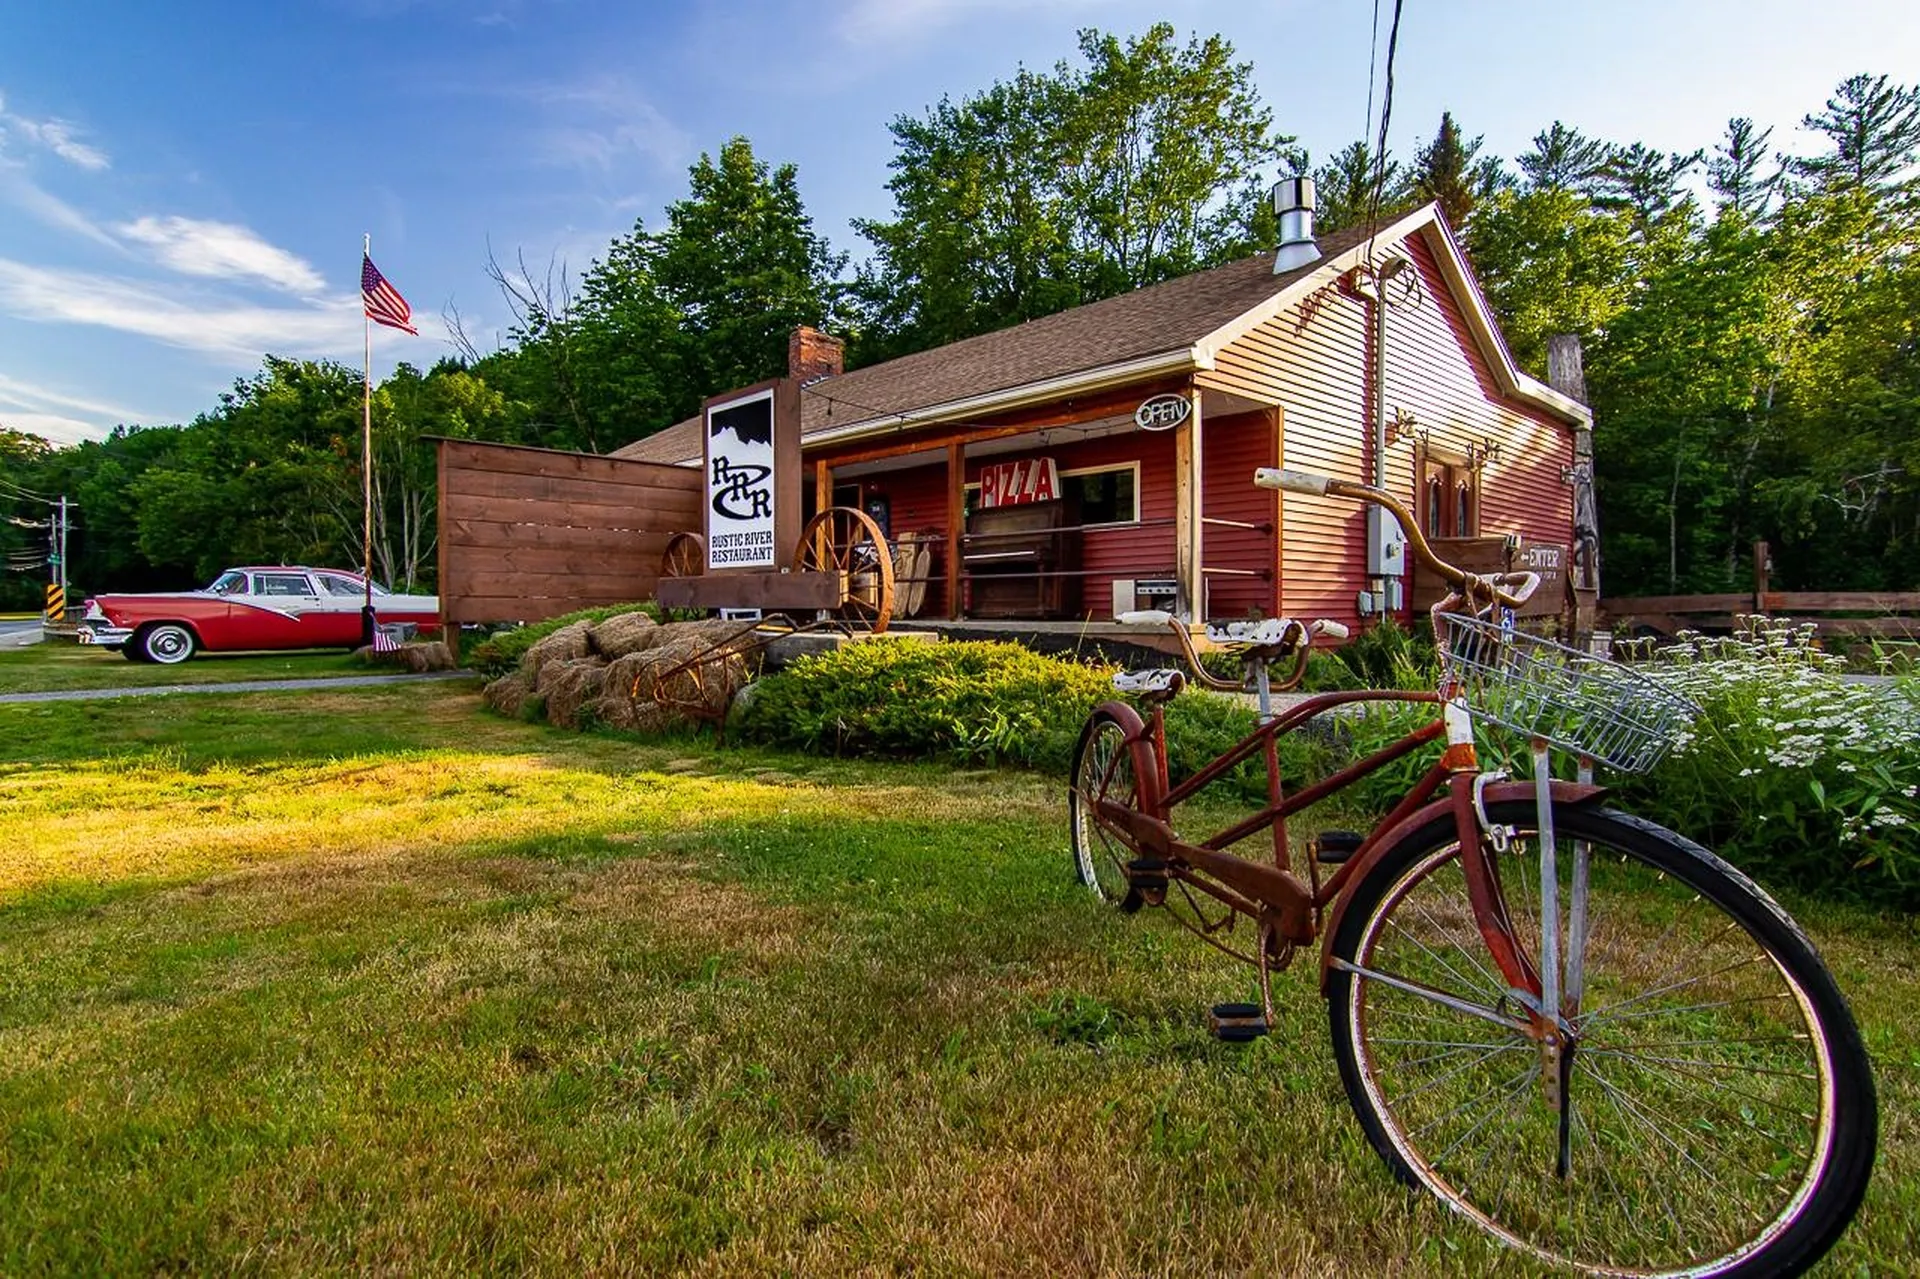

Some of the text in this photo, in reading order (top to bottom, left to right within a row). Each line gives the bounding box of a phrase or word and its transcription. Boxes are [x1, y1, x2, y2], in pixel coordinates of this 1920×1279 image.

[1140, 401, 1184, 424] OPEN
[979, 457, 1061, 509] PIZZA
[712, 531, 772, 548] RUSTIC RIVER
[712, 547, 772, 563] RESTAURANT
[1529, 549, 1559, 567] ENTER
